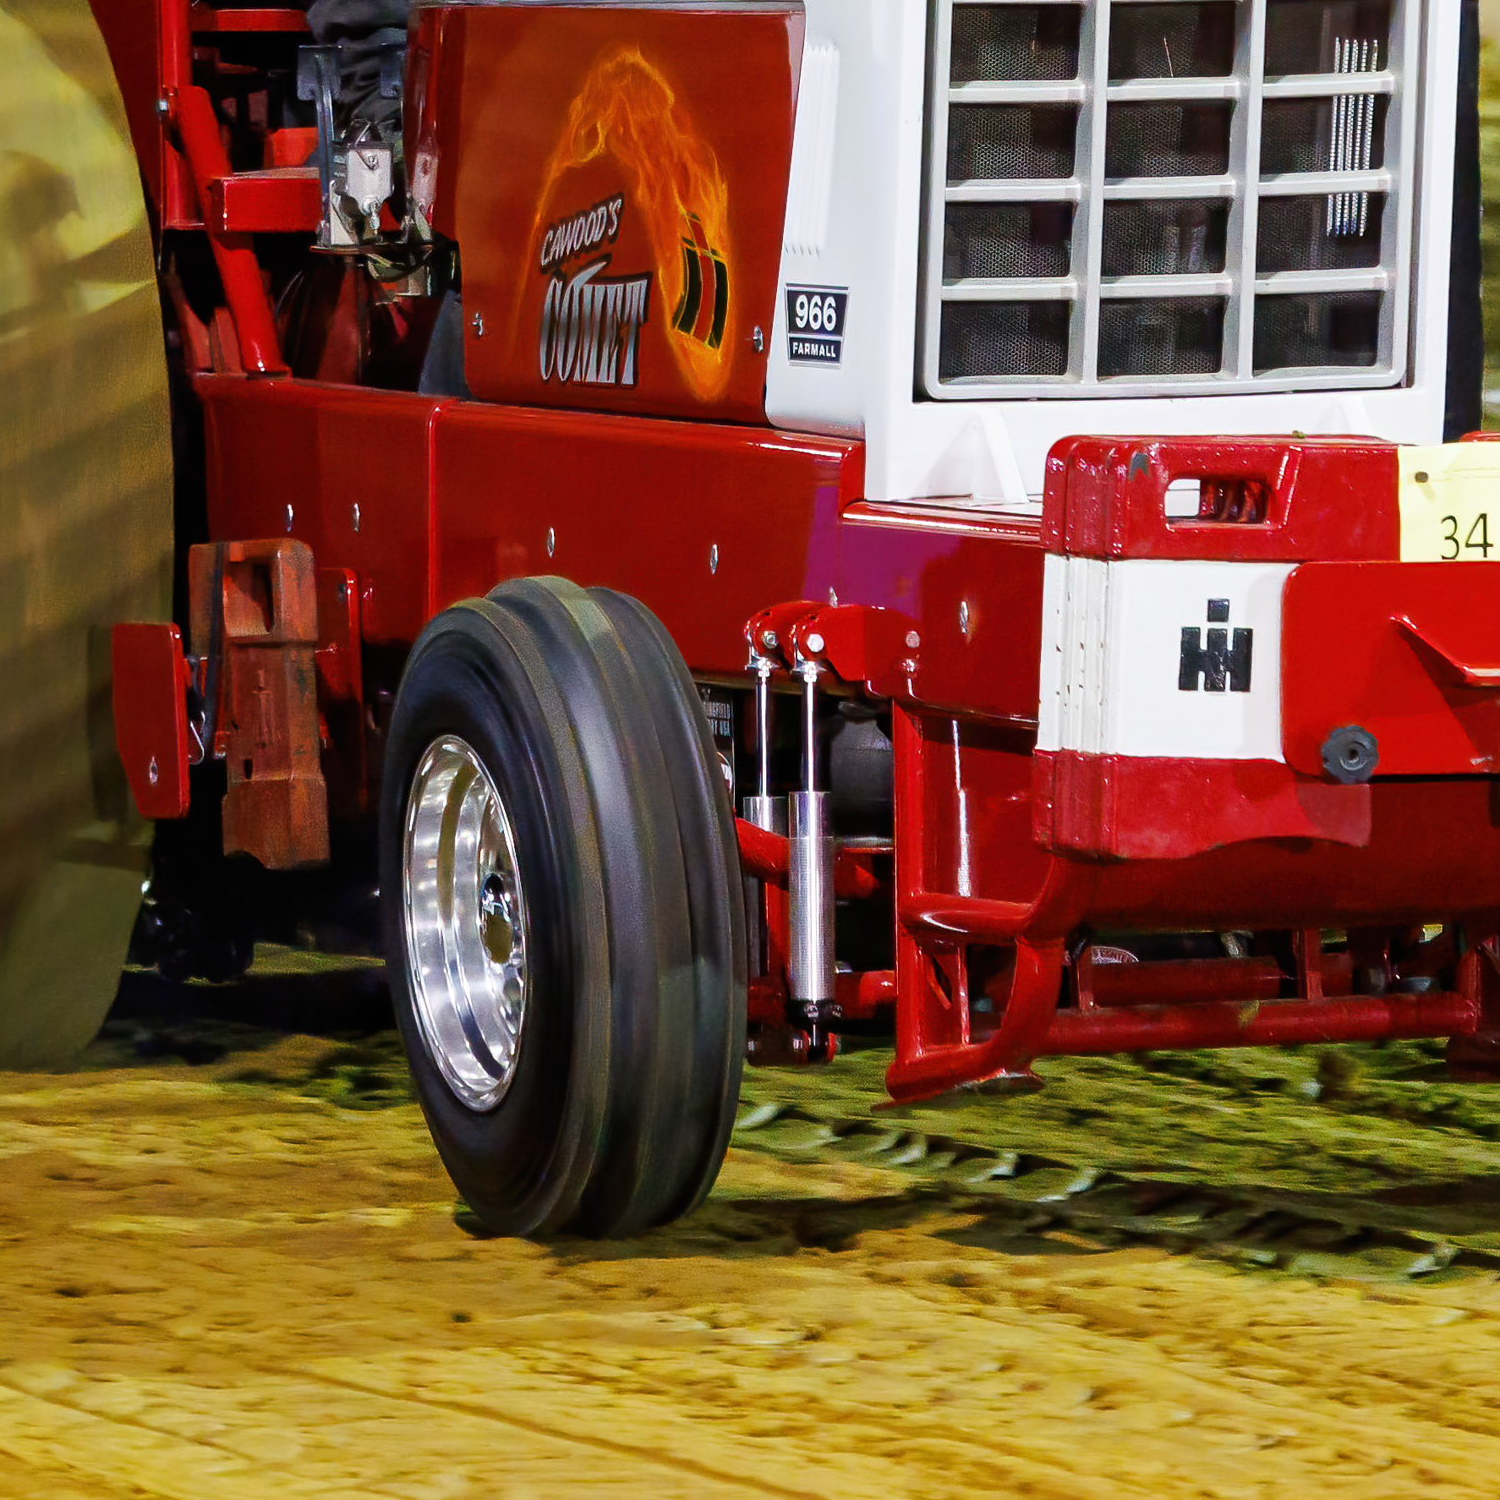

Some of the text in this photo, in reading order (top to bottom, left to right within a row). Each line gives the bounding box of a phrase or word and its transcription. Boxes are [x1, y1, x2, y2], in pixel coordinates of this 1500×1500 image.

[540, 198, 623, 266] CAWOOD'S
[795, 294, 837, 331] 966
[792, 342, 837, 358] FARMALL
